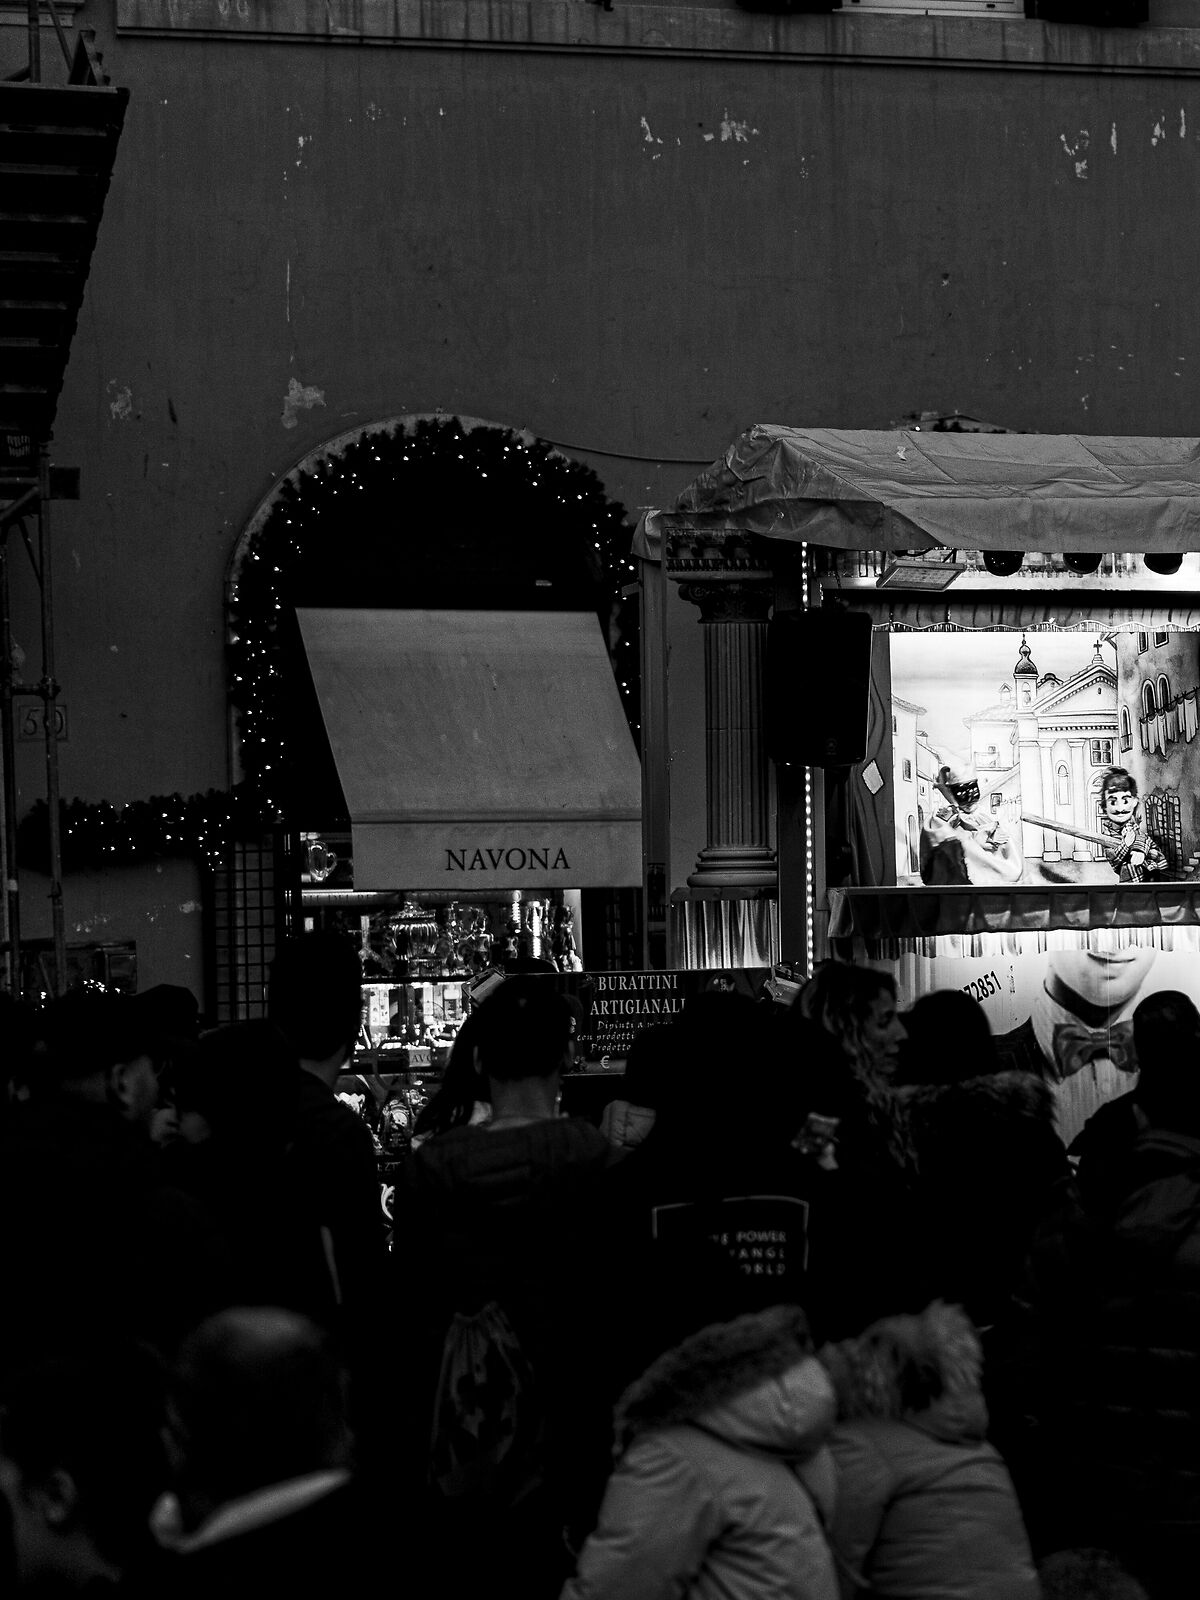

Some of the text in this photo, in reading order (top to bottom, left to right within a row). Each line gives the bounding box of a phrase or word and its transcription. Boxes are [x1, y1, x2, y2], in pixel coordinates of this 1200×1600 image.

[445, 847, 570, 871] NAVONA
[598, 974, 678, 991] BURATTINI
[958, 970, 1002, 1003] 72851
[590, 998, 686, 1016] ARTIGIANALI
[597, 1020, 634, 1032] Dipinti
[576, 1031, 635, 1043] con prodotti
[590, 1042, 632, 1055] Prodotto
